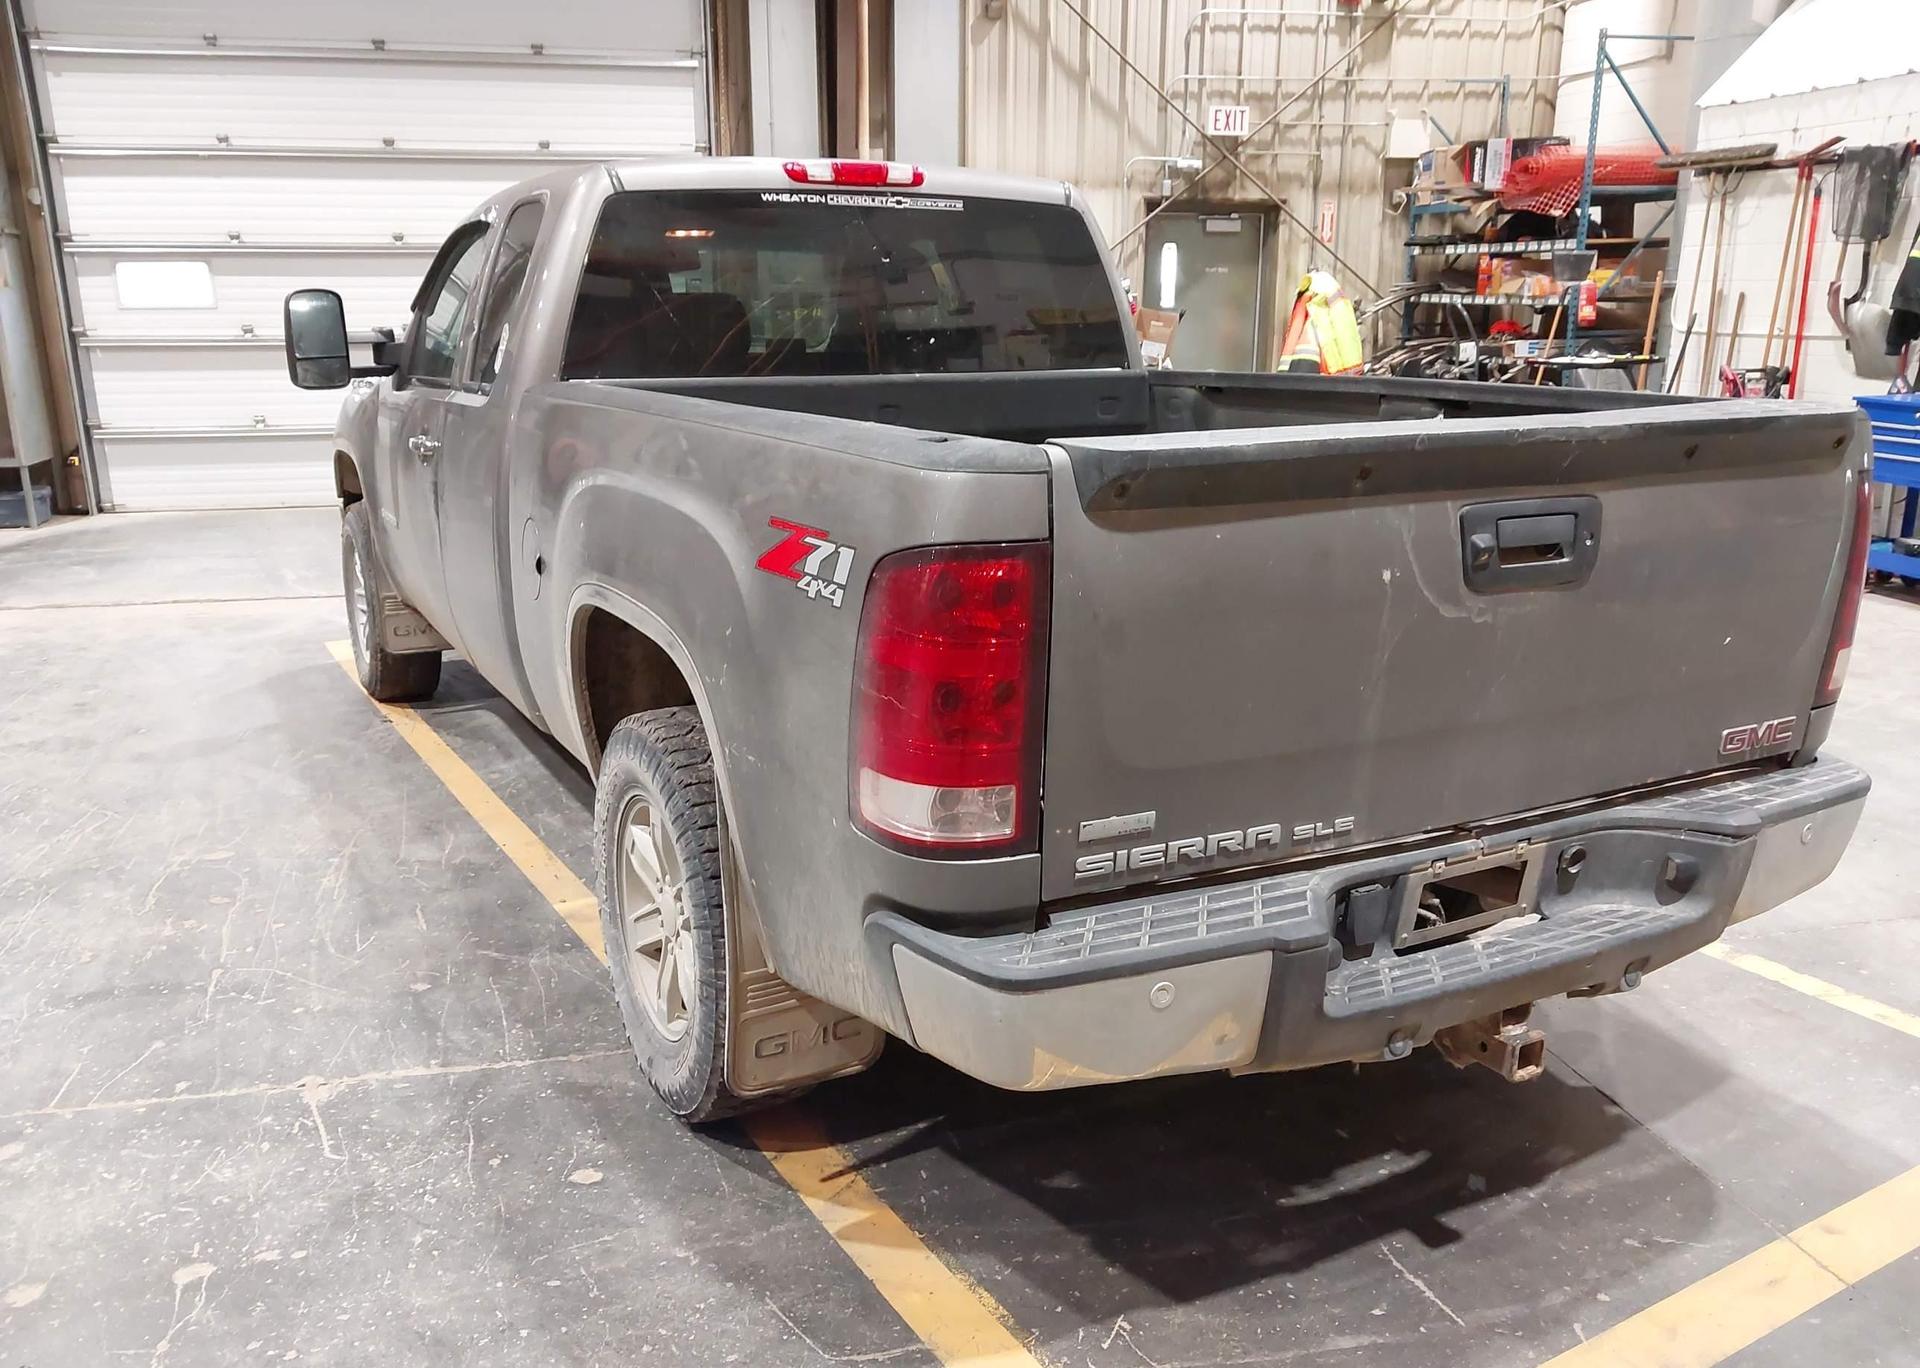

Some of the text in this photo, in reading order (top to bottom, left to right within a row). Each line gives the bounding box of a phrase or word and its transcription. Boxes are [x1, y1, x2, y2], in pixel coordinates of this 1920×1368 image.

[1213, 109, 1247, 132] EXIT
[761, 192, 826, 203] WHEATON
[827, 194, 889, 207] CHEVROLET
[754, 515, 856, 588] Z71
[1720, 715, 1797, 755] GMC
[1074, 823, 1281, 880] SIERRA
[1292, 816, 1355, 840] SLE
[753, 1015, 862, 1059] GMC
